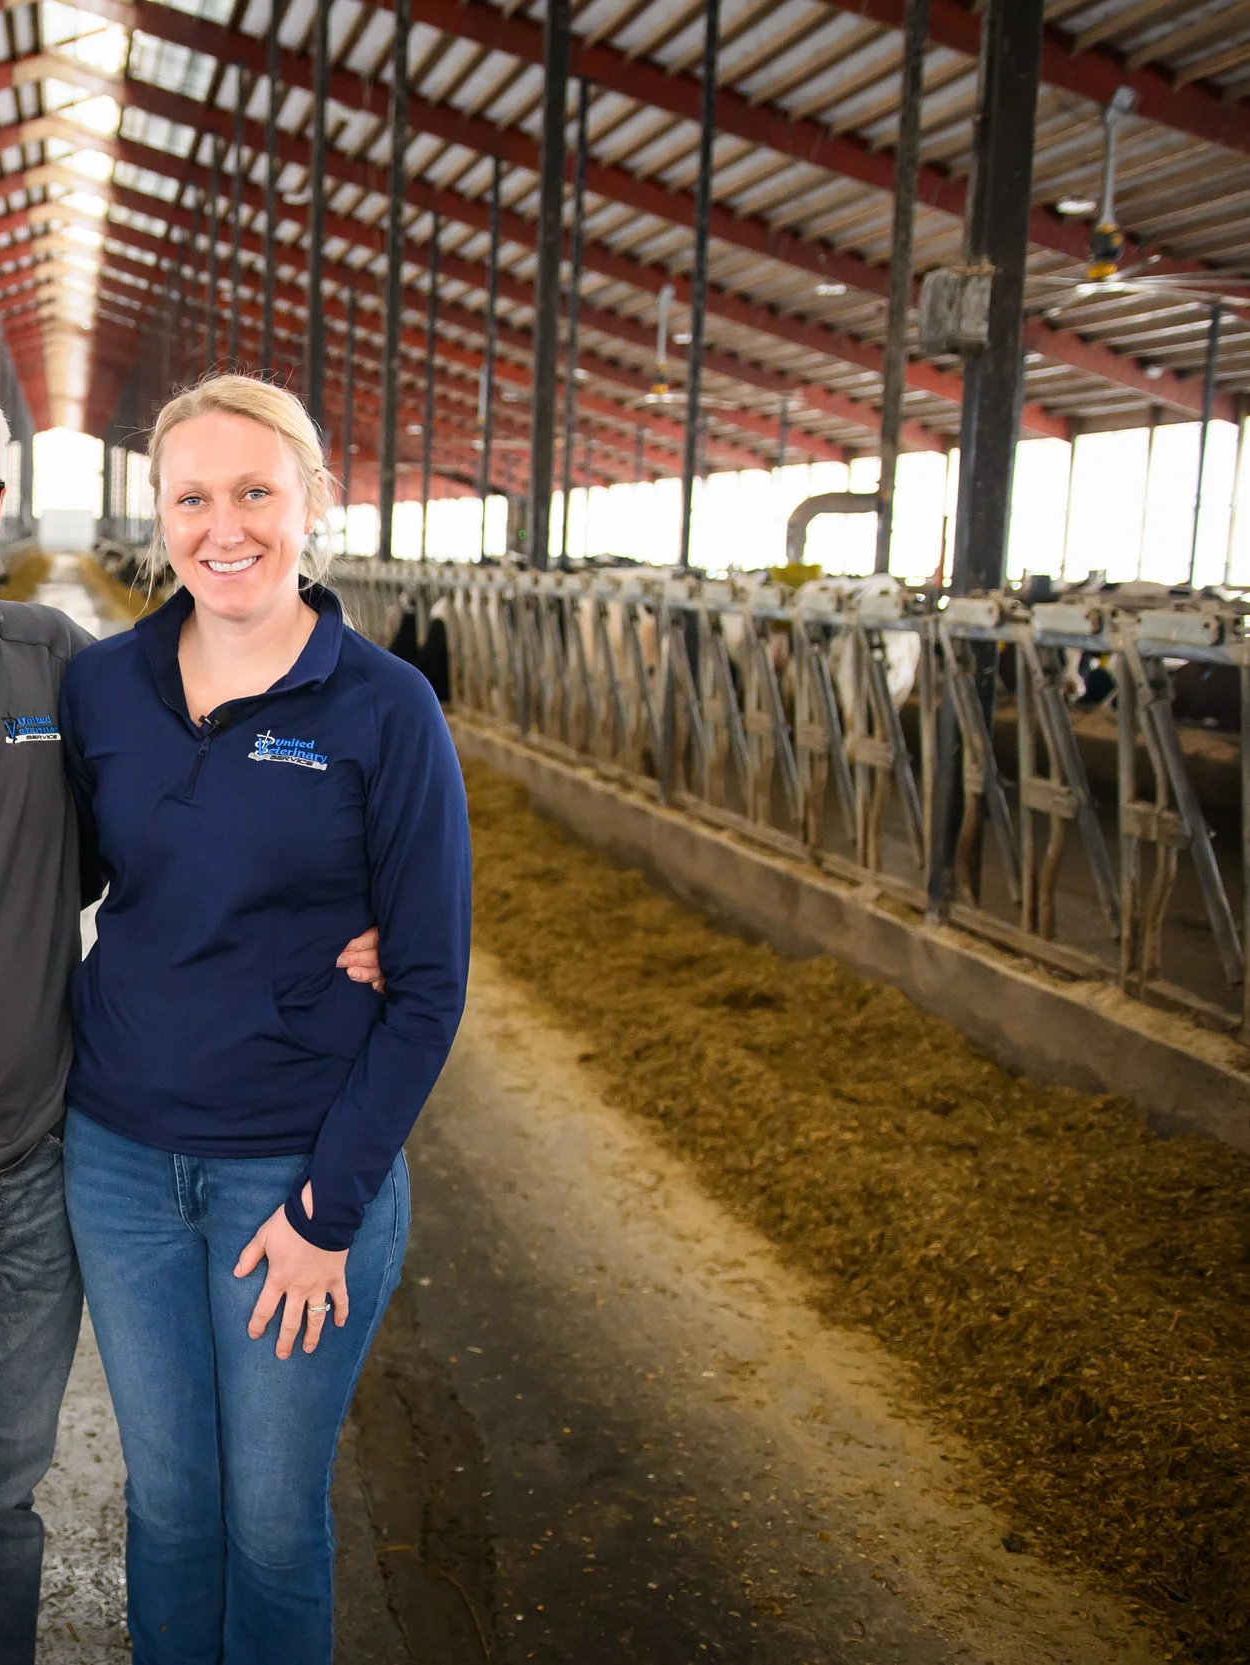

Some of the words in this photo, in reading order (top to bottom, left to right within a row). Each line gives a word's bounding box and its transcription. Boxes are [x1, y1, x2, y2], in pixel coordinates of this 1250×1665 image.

[17, 715, 52, 725] United
[275, 738, 315, 749] United
[258, 737, 328, 764] Veterinary
[270, 755, 314, 766] SERVICE
